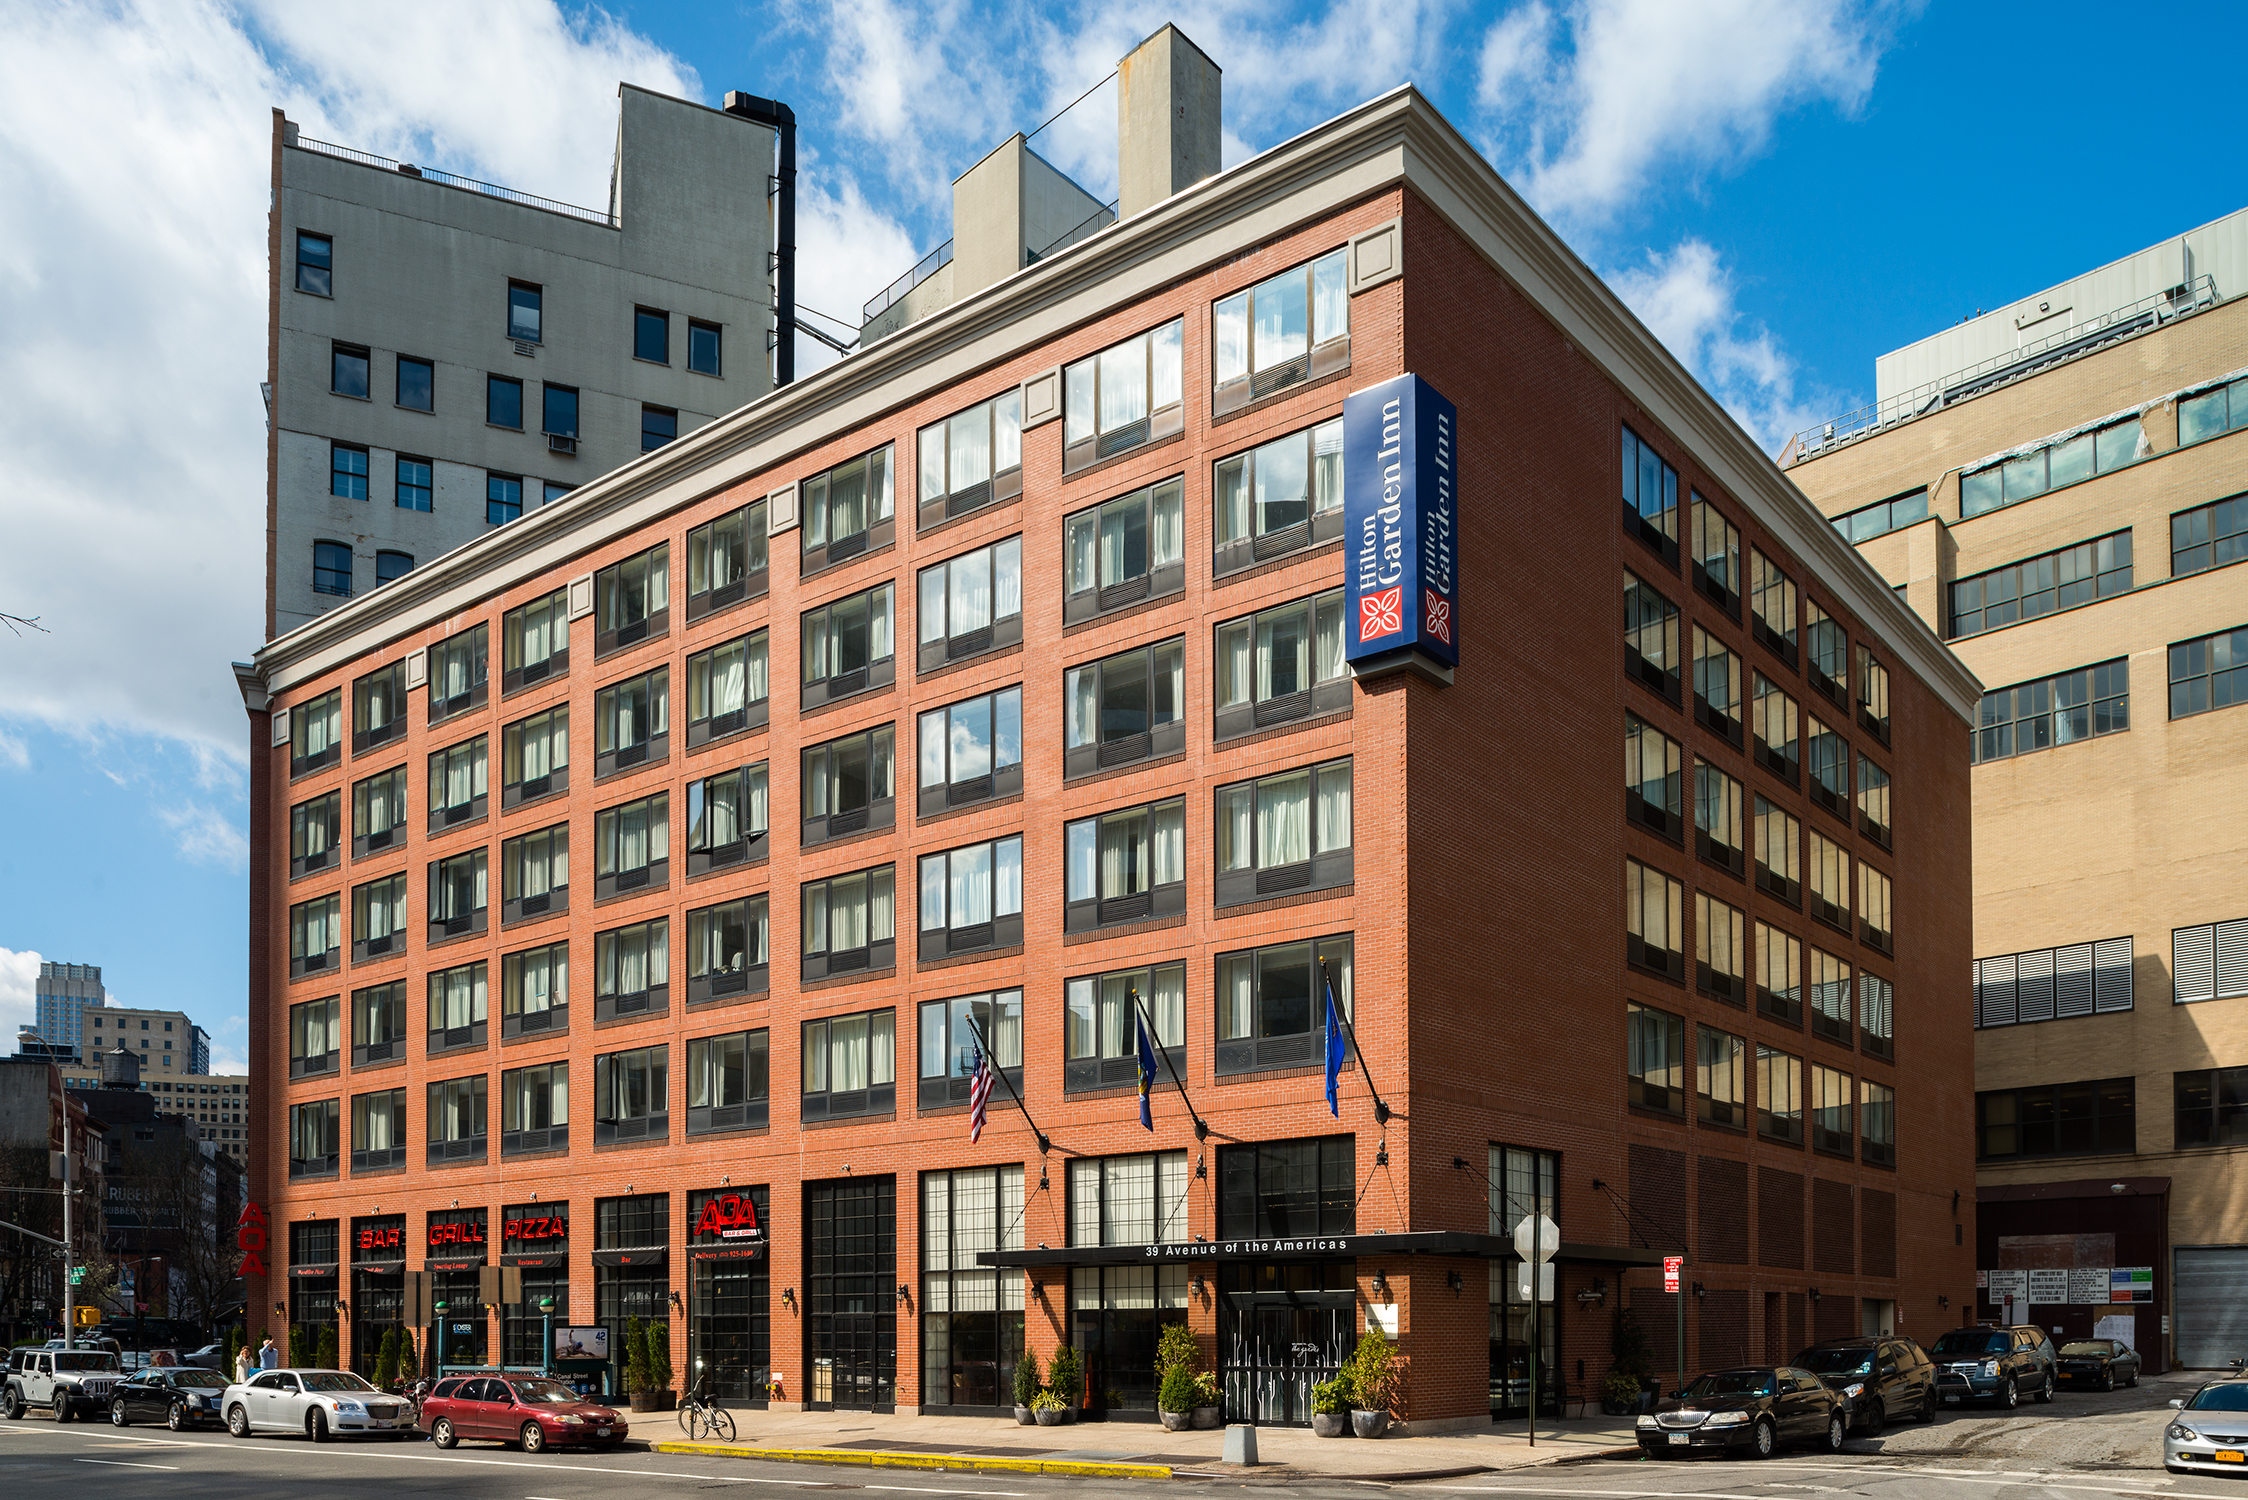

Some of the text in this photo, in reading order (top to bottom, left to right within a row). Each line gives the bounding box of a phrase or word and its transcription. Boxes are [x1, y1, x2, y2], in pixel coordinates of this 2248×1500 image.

[1377, 396, 1402, 585] Garden Inn
[1435, 413, 1450, 595] Garden Inn
[1360, 513, 1377, 591] Hilton
[1425, 511, 1436, 586] Hilton
[694, 1194, 756, 1236] AOA
[360, 1228, 400, 1249] BAR
[429, 1222, 483, 1245] GRILL
[504, 1216, 565, 1240] PIZZA
[695, 1252, 717, 1260] Delivery
[1146, 1239, 1347, 1257] 39 Avenue of the Americas
[433, 1262, 468, 1271] Sporting Lounge
[595, 1331, 606, 1341] 42
